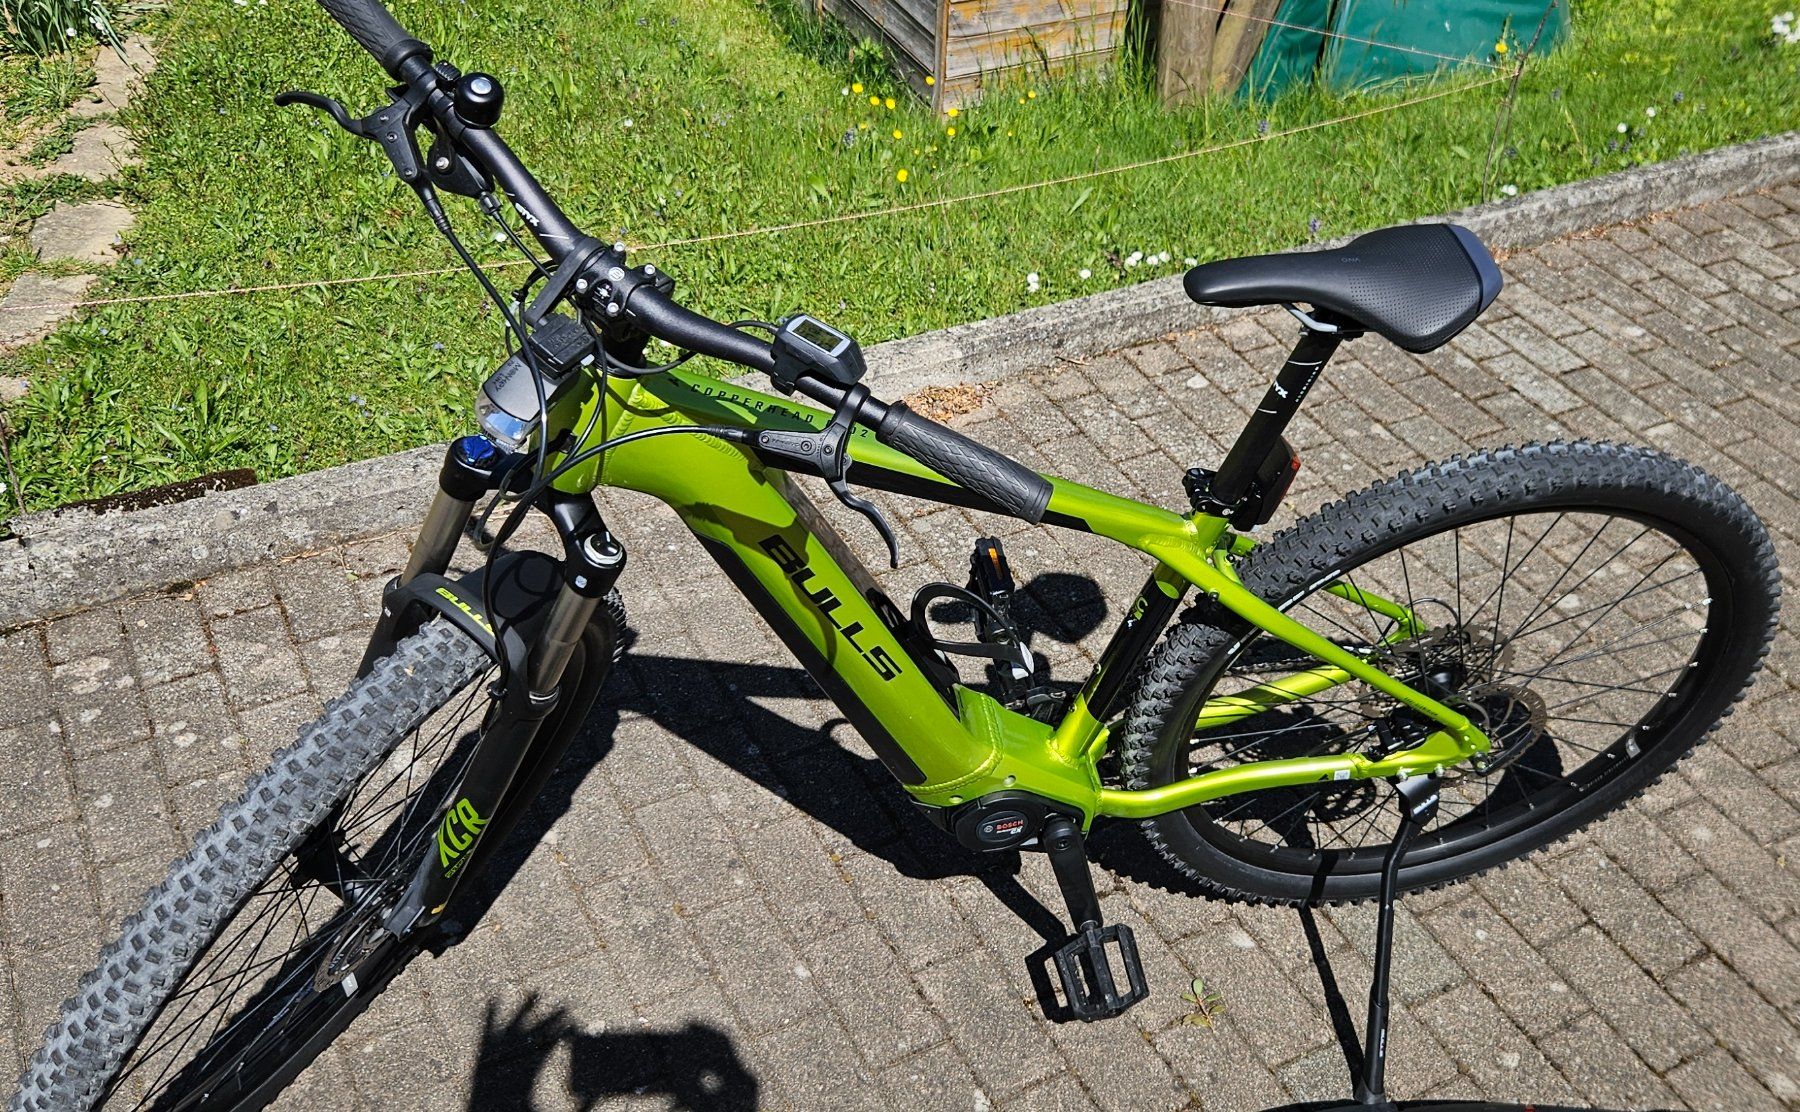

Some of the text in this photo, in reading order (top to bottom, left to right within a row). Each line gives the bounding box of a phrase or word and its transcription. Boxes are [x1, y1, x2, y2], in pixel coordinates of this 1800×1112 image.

[690, 383, 813, 423] COPPERHEAD
[758, 534, 903, 682] BULLS
[438, 798, 491, 868] XCR
[996, 819, 1024, 830] BOSCH
